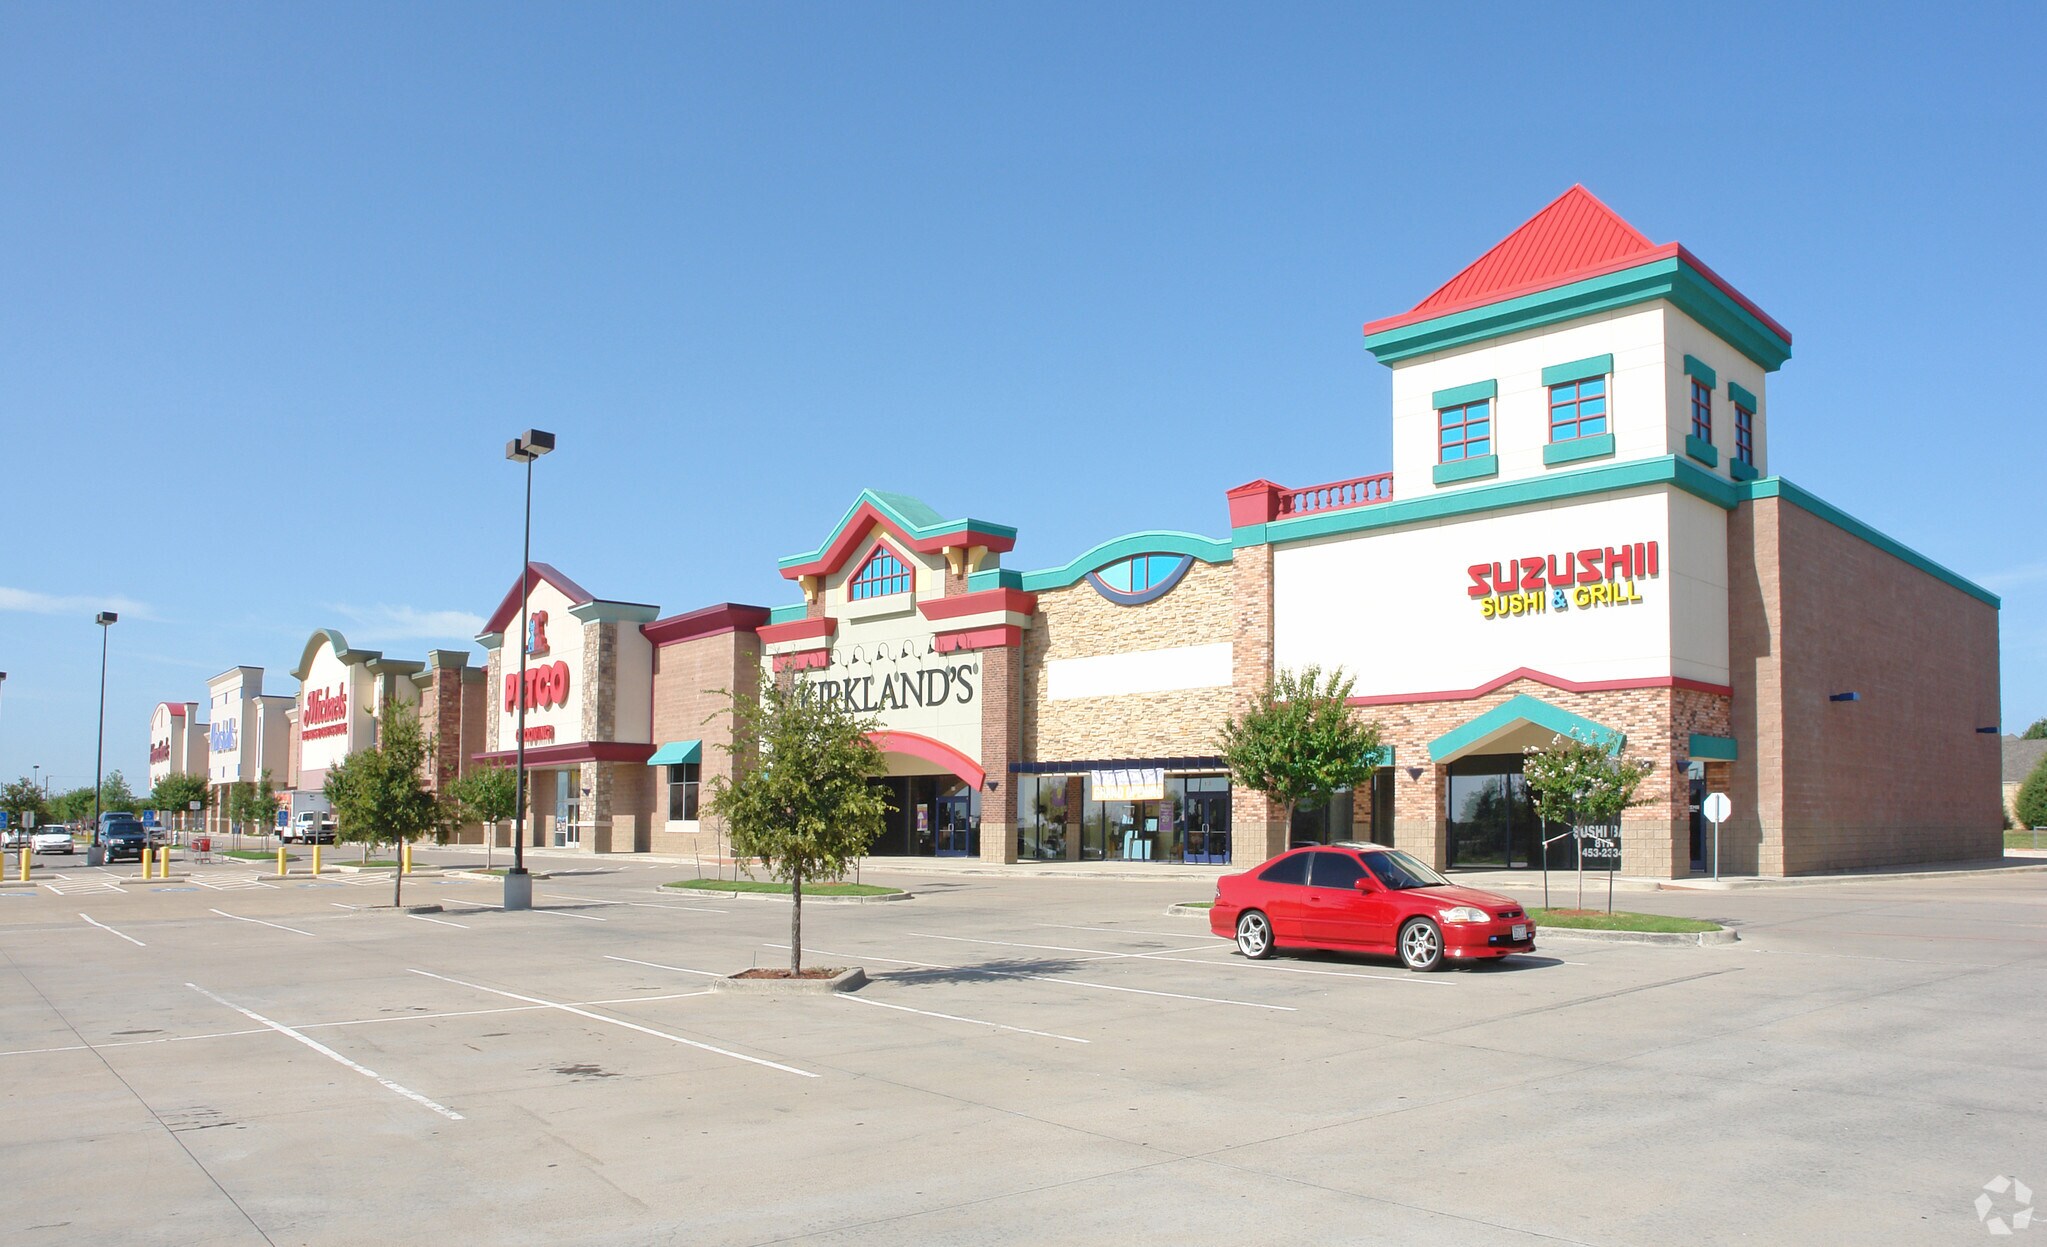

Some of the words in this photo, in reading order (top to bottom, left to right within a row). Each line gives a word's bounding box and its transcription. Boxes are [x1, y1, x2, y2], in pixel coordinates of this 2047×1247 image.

[1467, 540, 1658, 596] SUZUSHII
[1480, 590, 1545, 615] SUSHI
[1551, 588, 1567, 607] &
[1573, 580, 1640, 606] GRILL
[304, 682, 347, 727] Michaels
[516, 725, 554, 742] GOOMING
[1573, 825, 1607, 838] SUSHI
